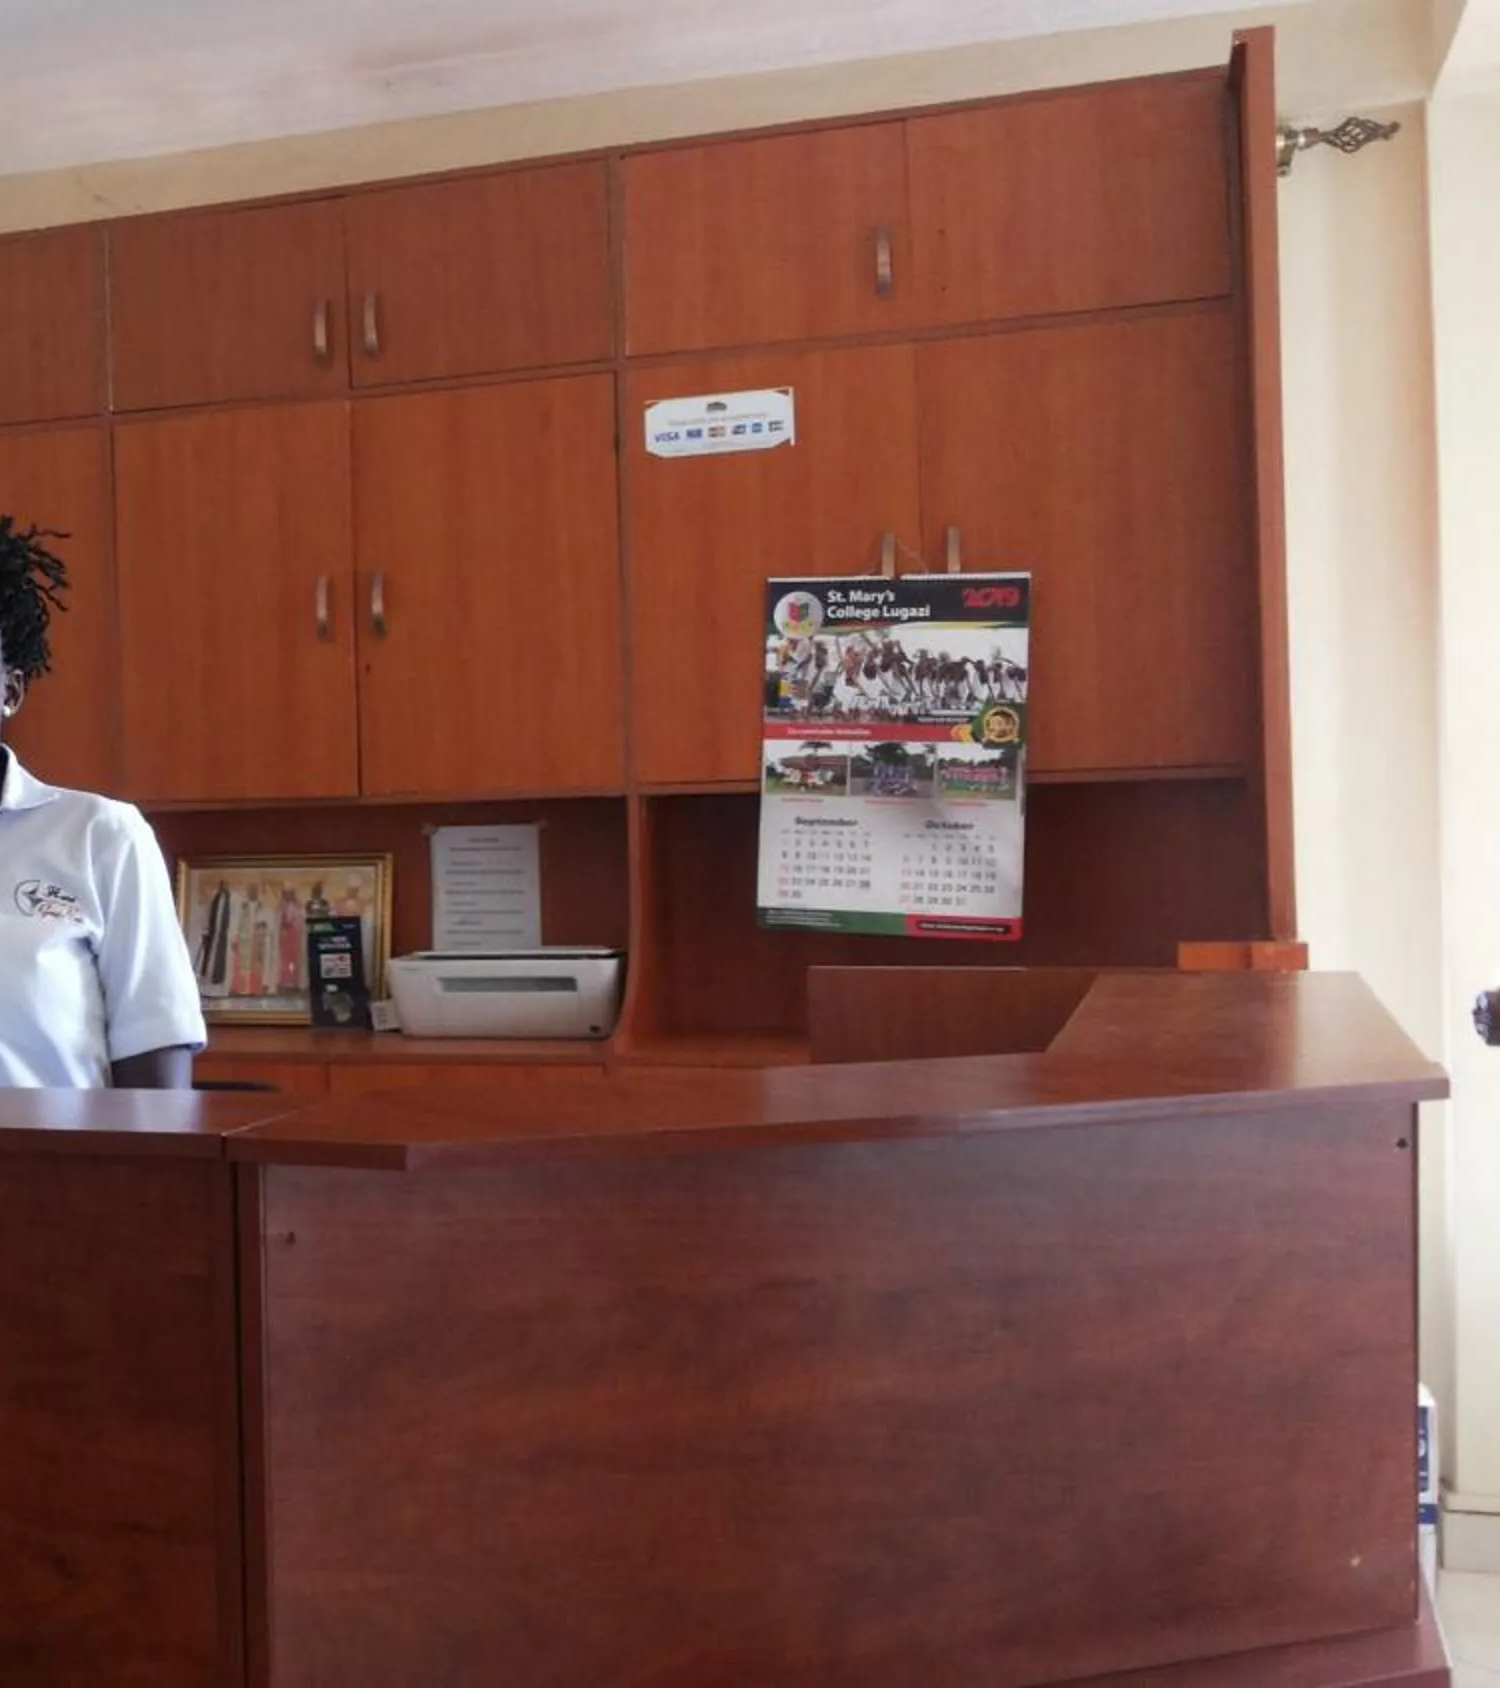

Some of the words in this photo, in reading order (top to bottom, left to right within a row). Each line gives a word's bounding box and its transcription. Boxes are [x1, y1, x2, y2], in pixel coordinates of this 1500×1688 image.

[654, 431, 680, 443] VISA
[827, 590, 847, 603] St.
[850, 589, 895, 605] Mary's
[963, 586, 1021, 608] 2019
[827, 605, 880, 620] College
[883, 604, 931, 620] Lugazi
[794, 816, 858, 827] September
[924, 819, 975, 830] October
